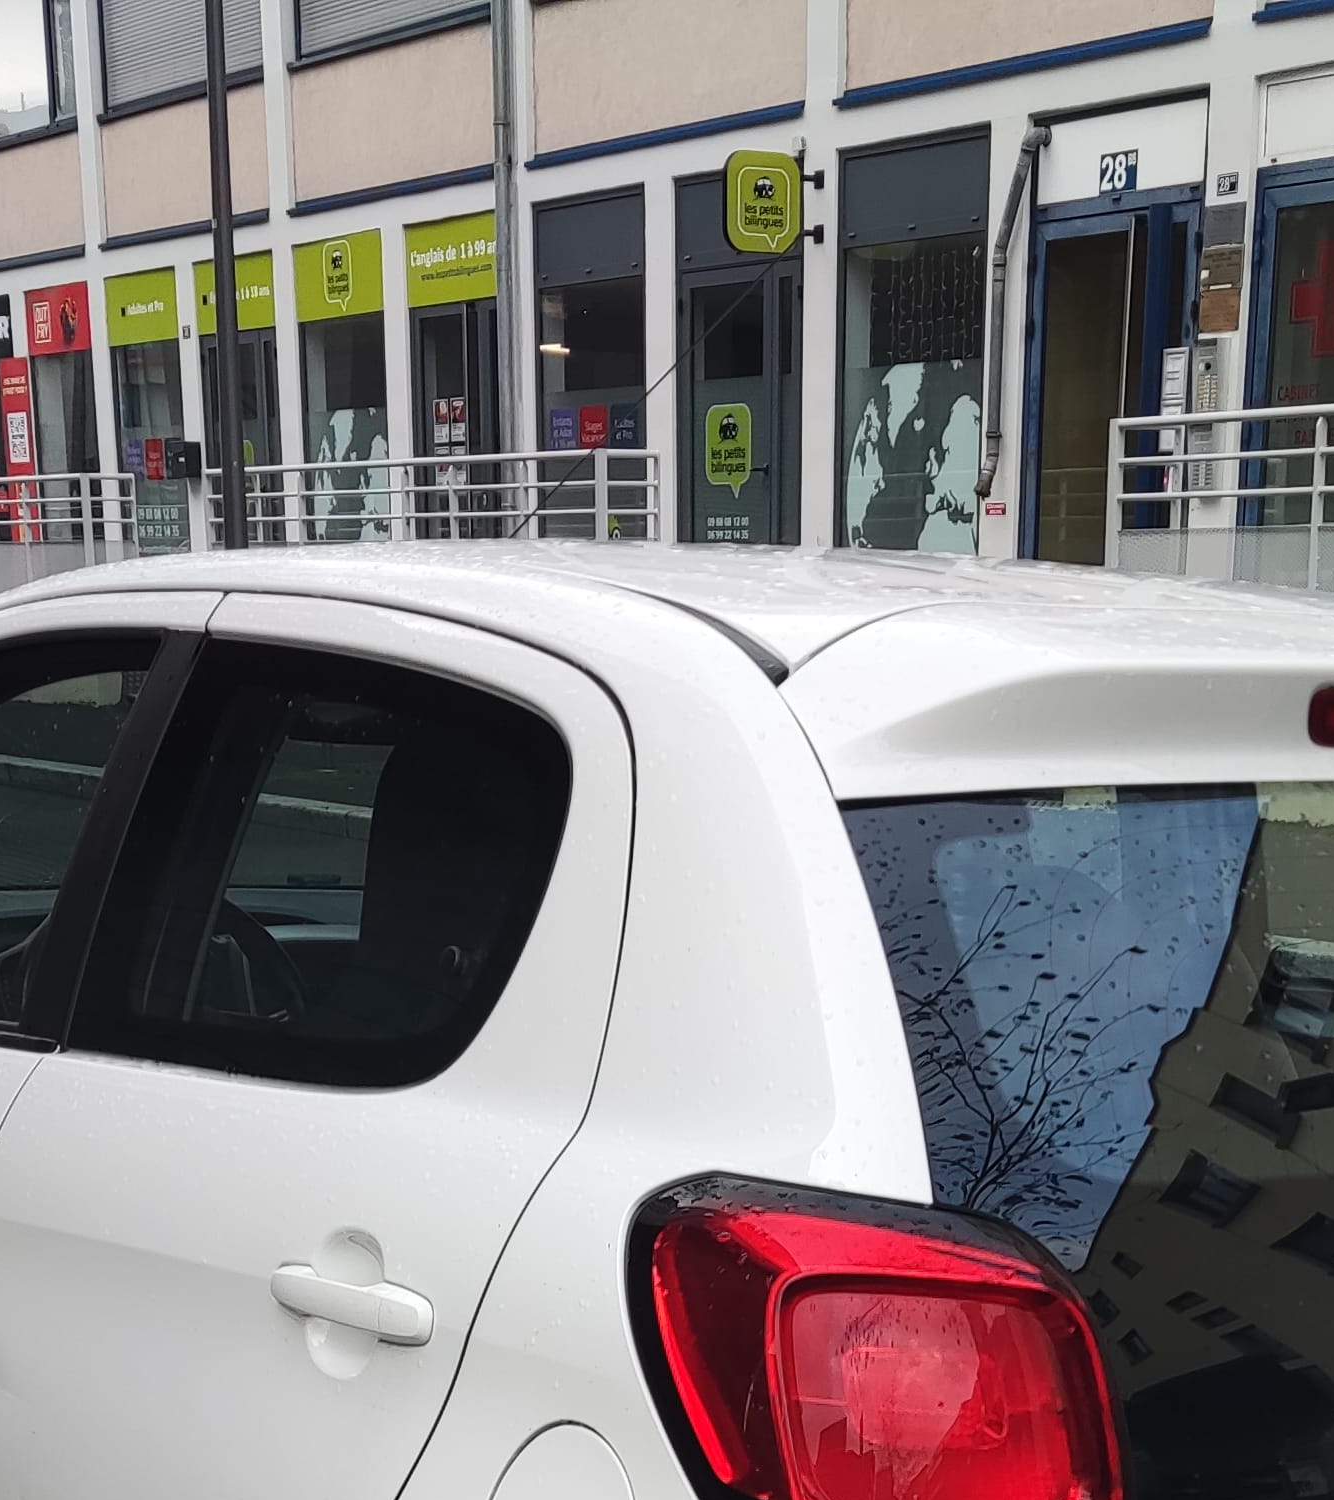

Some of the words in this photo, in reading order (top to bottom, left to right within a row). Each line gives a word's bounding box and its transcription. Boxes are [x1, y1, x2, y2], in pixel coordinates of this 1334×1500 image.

[1101, 154, 1127, 191] 28
[744, 202, 757, 214] les
[759, 205, 783, 217] petits
[744, 215, 783, 229] bilingues
[411, 247, 444, 268] L'anglais
[446, 244, 457, 261] de
[460, 243, 466, 259] 1
[467, 240, 474, 258] à
[474, 239, 486, 256] 99
[711, 447, 722, 460] les
[724, 446, 746, 461] petits
